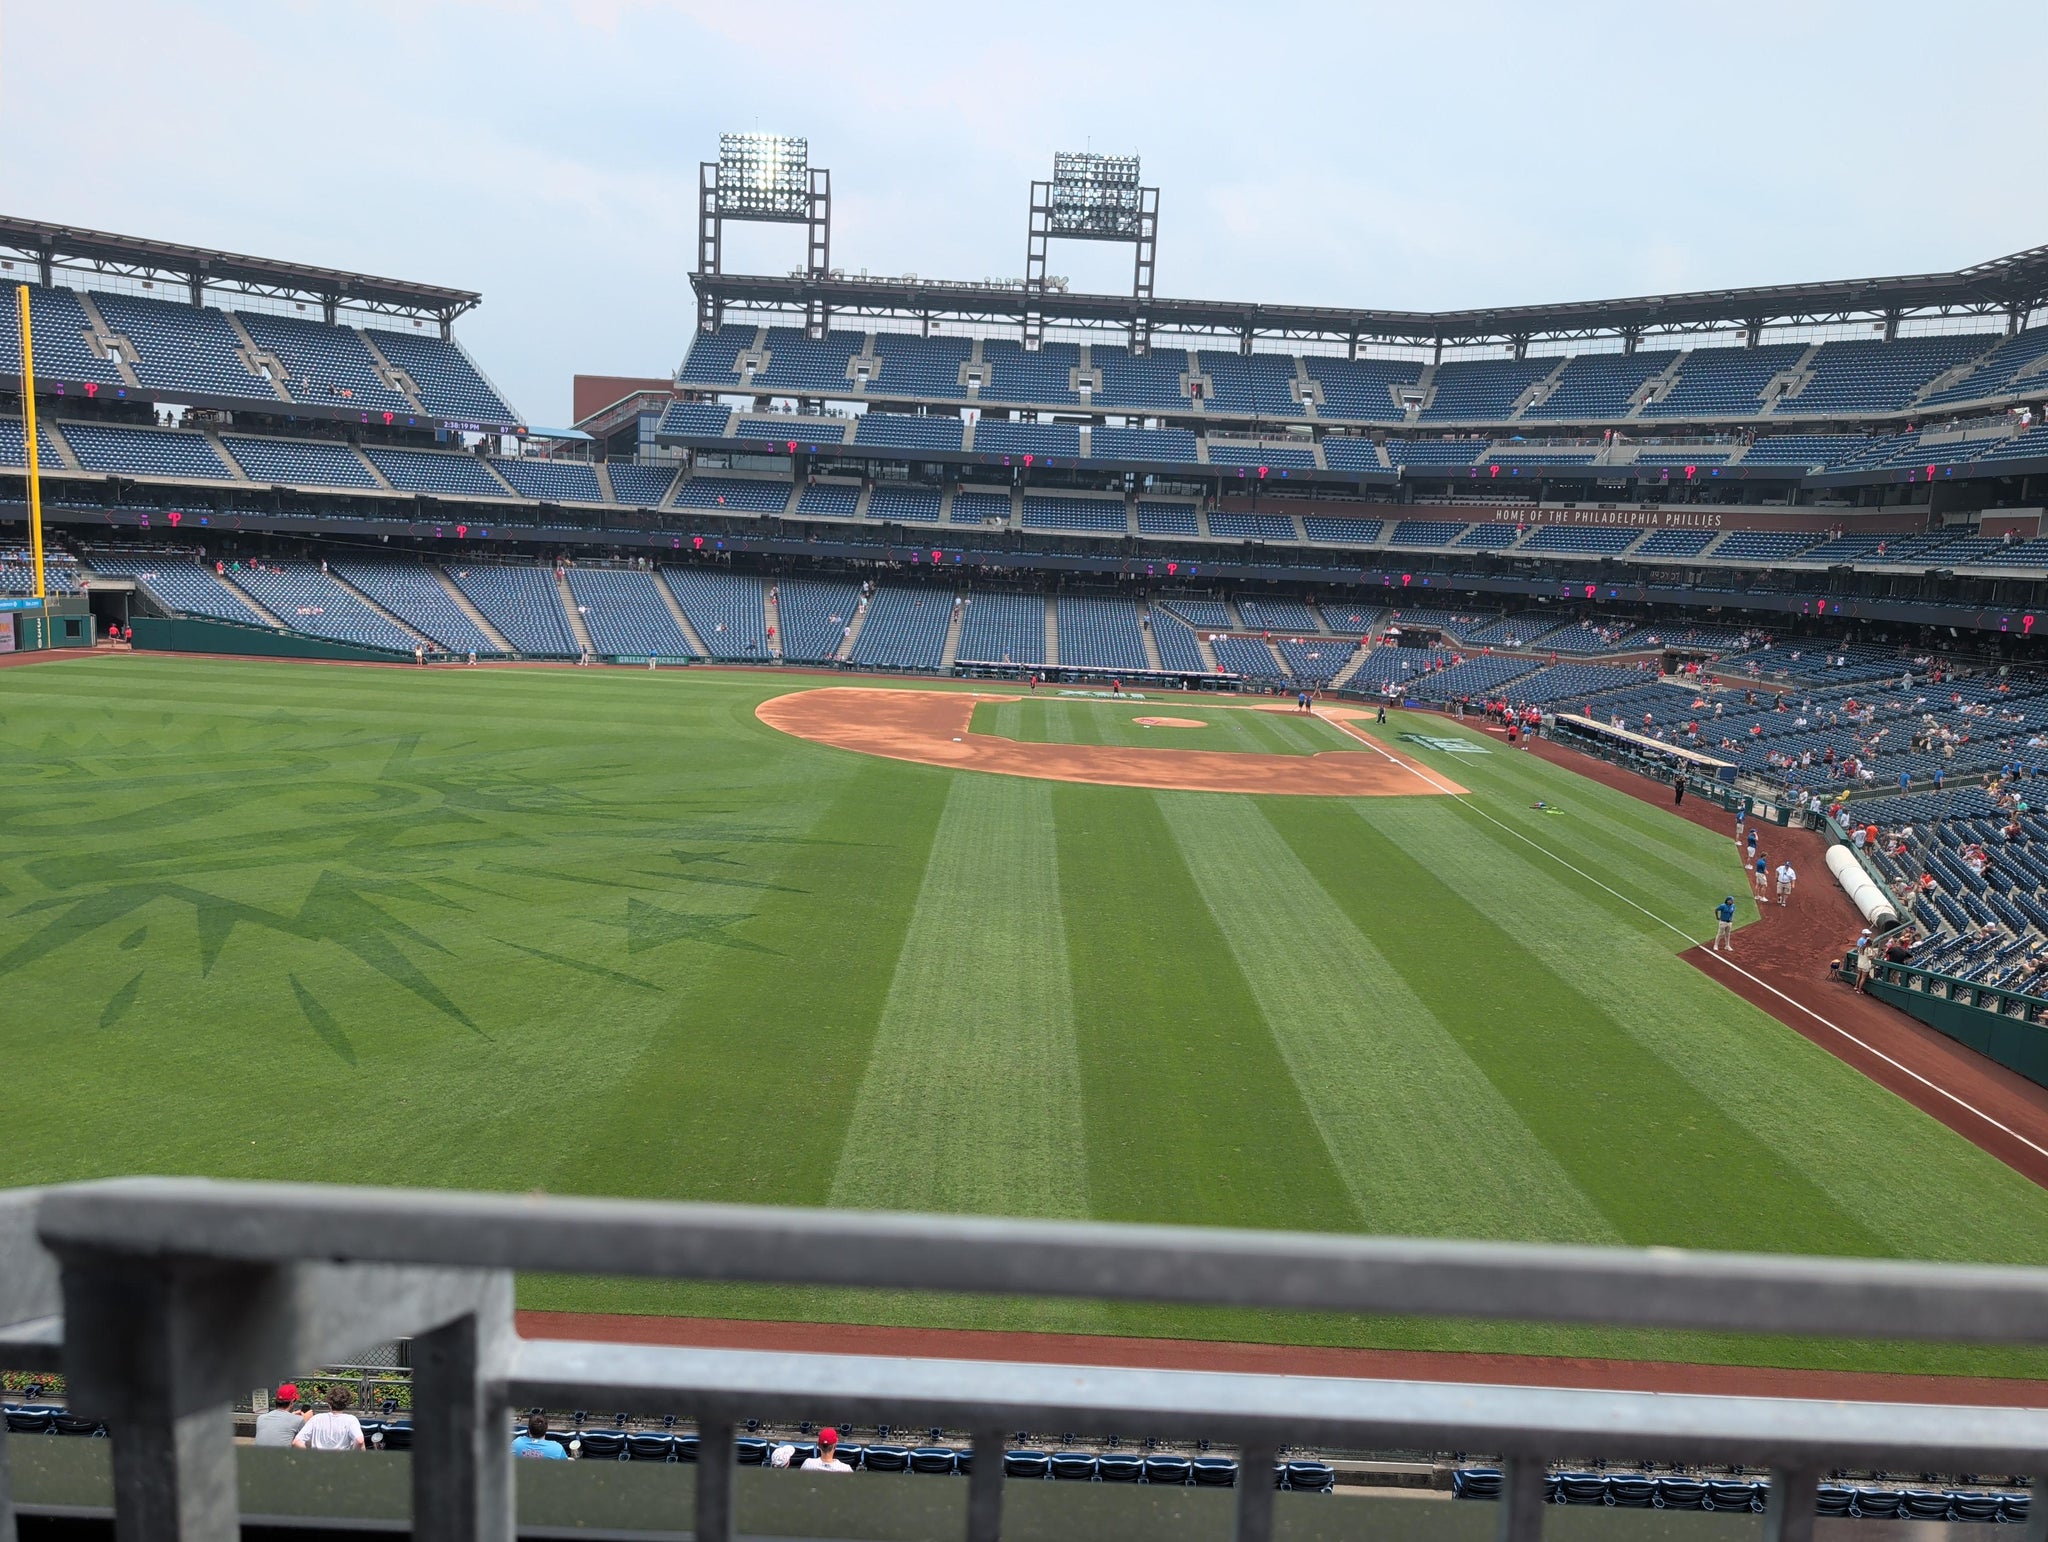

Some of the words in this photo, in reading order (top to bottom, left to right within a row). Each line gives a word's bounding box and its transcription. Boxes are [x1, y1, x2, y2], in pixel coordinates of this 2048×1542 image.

[469, 423, 480, 431] PM
[1496, 509, 1525, 521] HOME
[1530, 510, 1543, 521] OF
[1549, 511, 1568, 522] THE
[1575, 511, 1658, 524] PHILADELPHIA
[1666, 514, 1722, 526] PHILLIES
